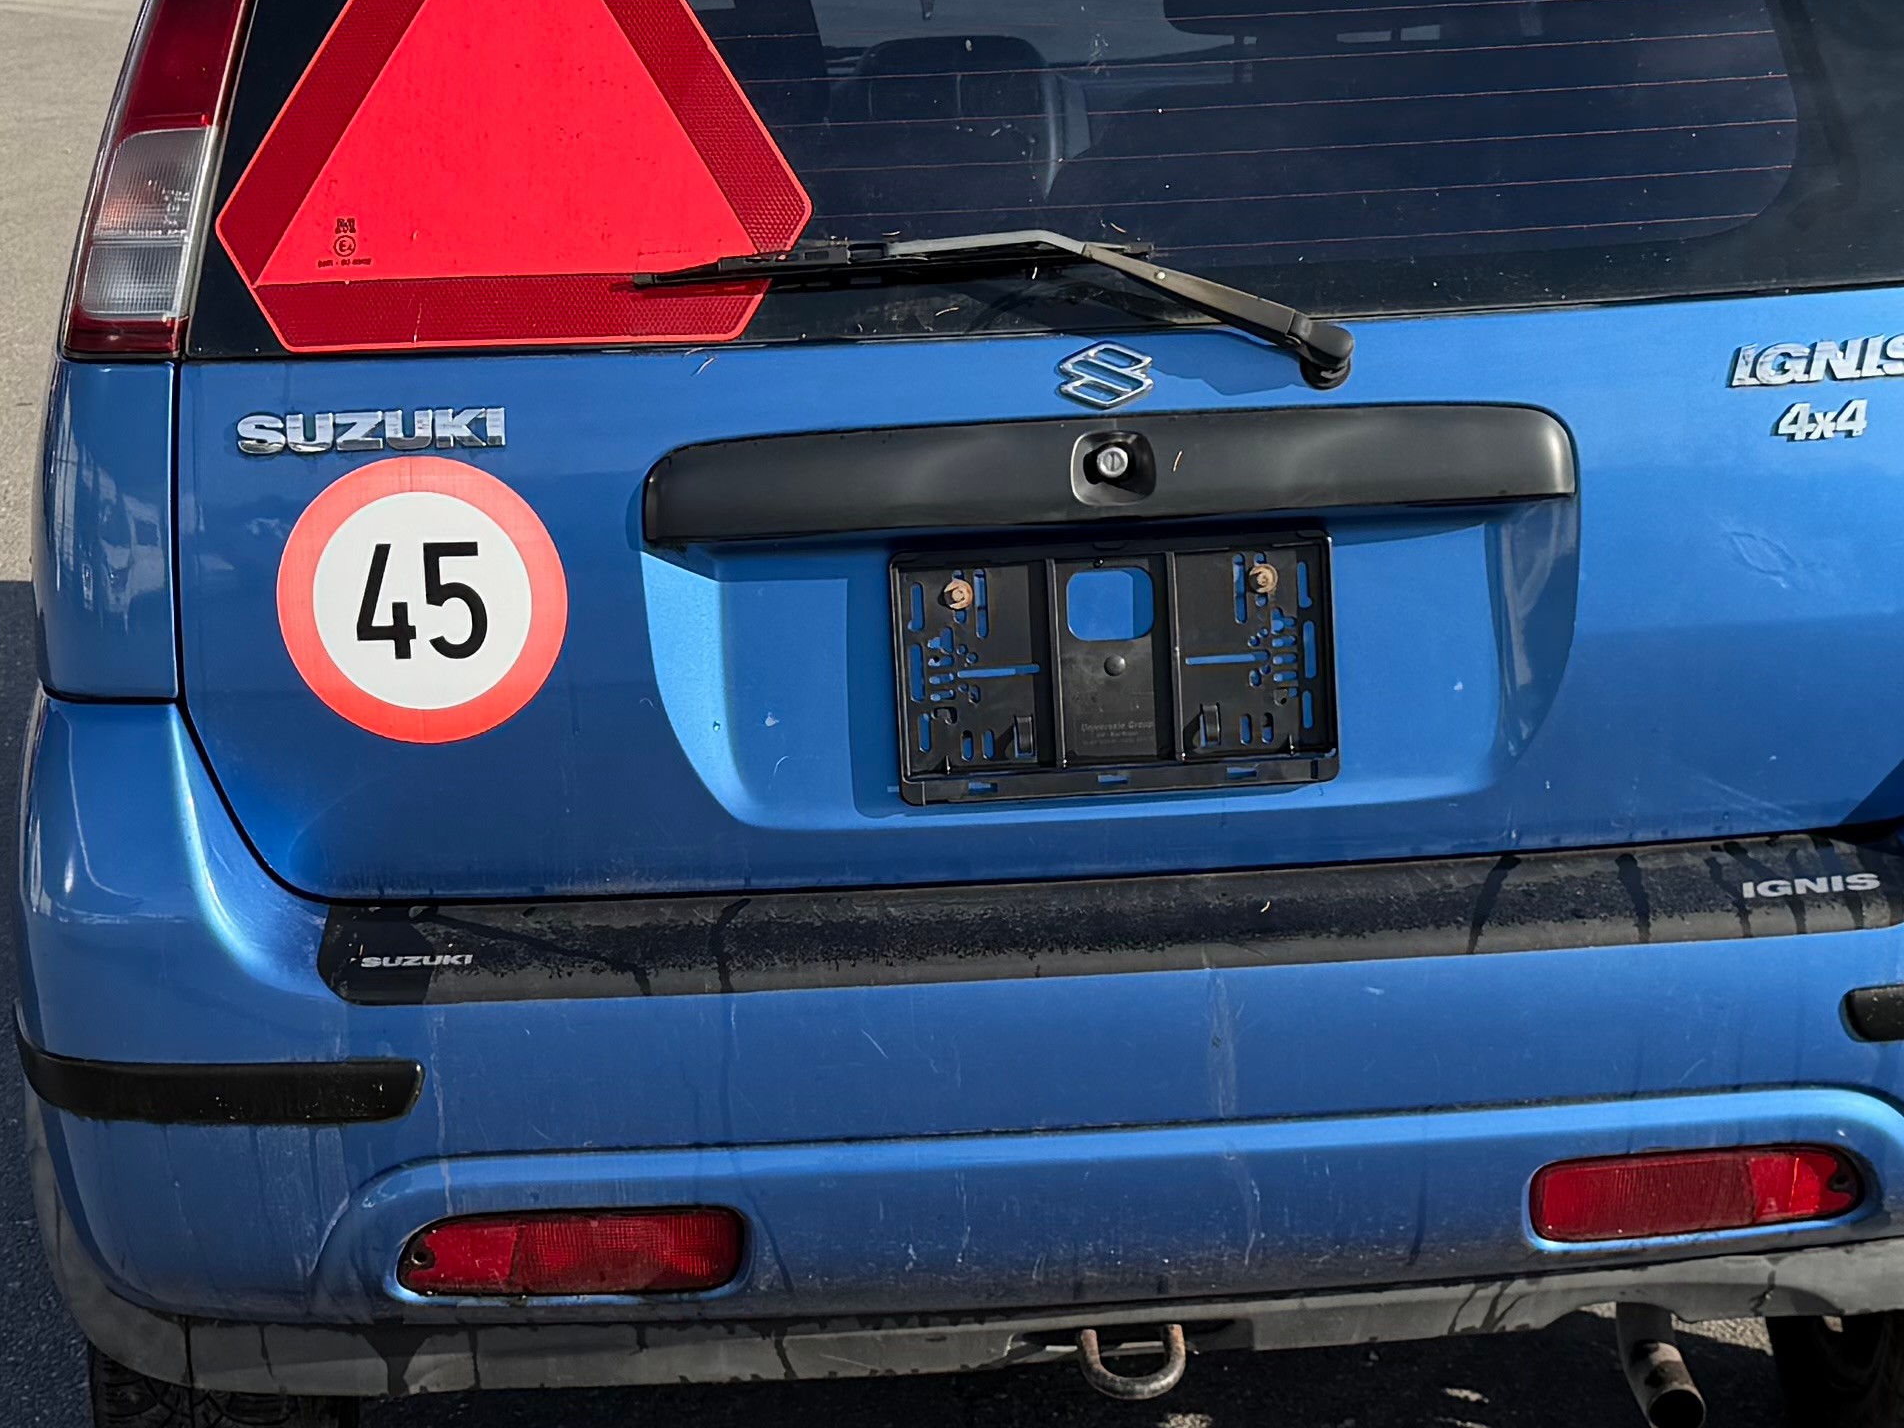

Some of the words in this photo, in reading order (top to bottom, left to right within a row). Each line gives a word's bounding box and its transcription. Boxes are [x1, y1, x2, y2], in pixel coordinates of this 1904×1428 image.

[237, 407, 506, 454] SUZUKI
[1775, 399, 1868, 441] 4x4
[356, 541, 488, 659] 45
[1742, 873, 1880, 898] IGNIS
[361, 954, 473, 967] SUZUKI
